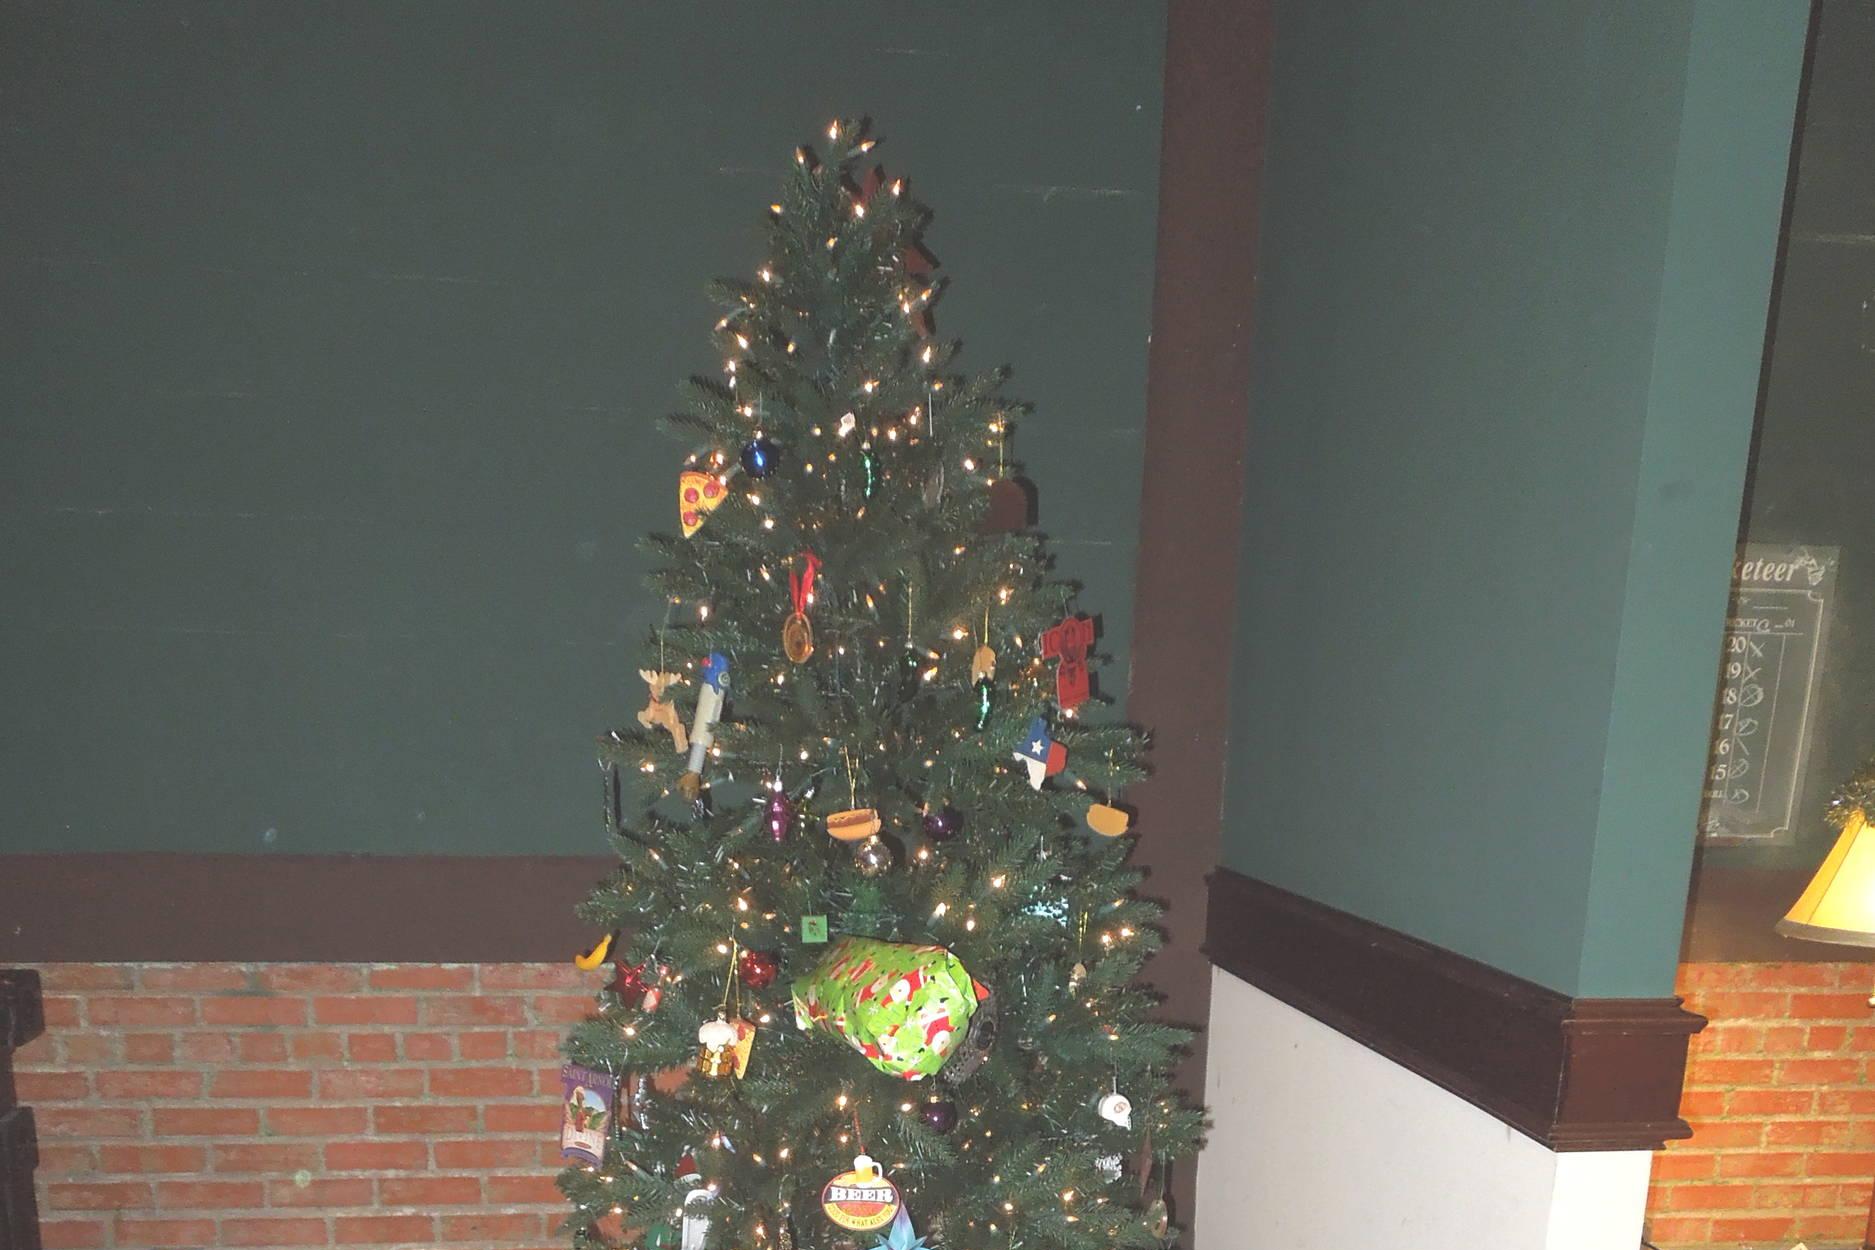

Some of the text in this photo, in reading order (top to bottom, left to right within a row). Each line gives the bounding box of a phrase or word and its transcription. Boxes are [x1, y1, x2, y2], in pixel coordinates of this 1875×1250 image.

[1740, 557, 1799, 582] eteer
[1727, 636, 1747, 653] 20
[1726, 662, 1742, 679] 19
[1722, 687, 1737, 705] 18
[829, 1186, 894, 1203] BEER
